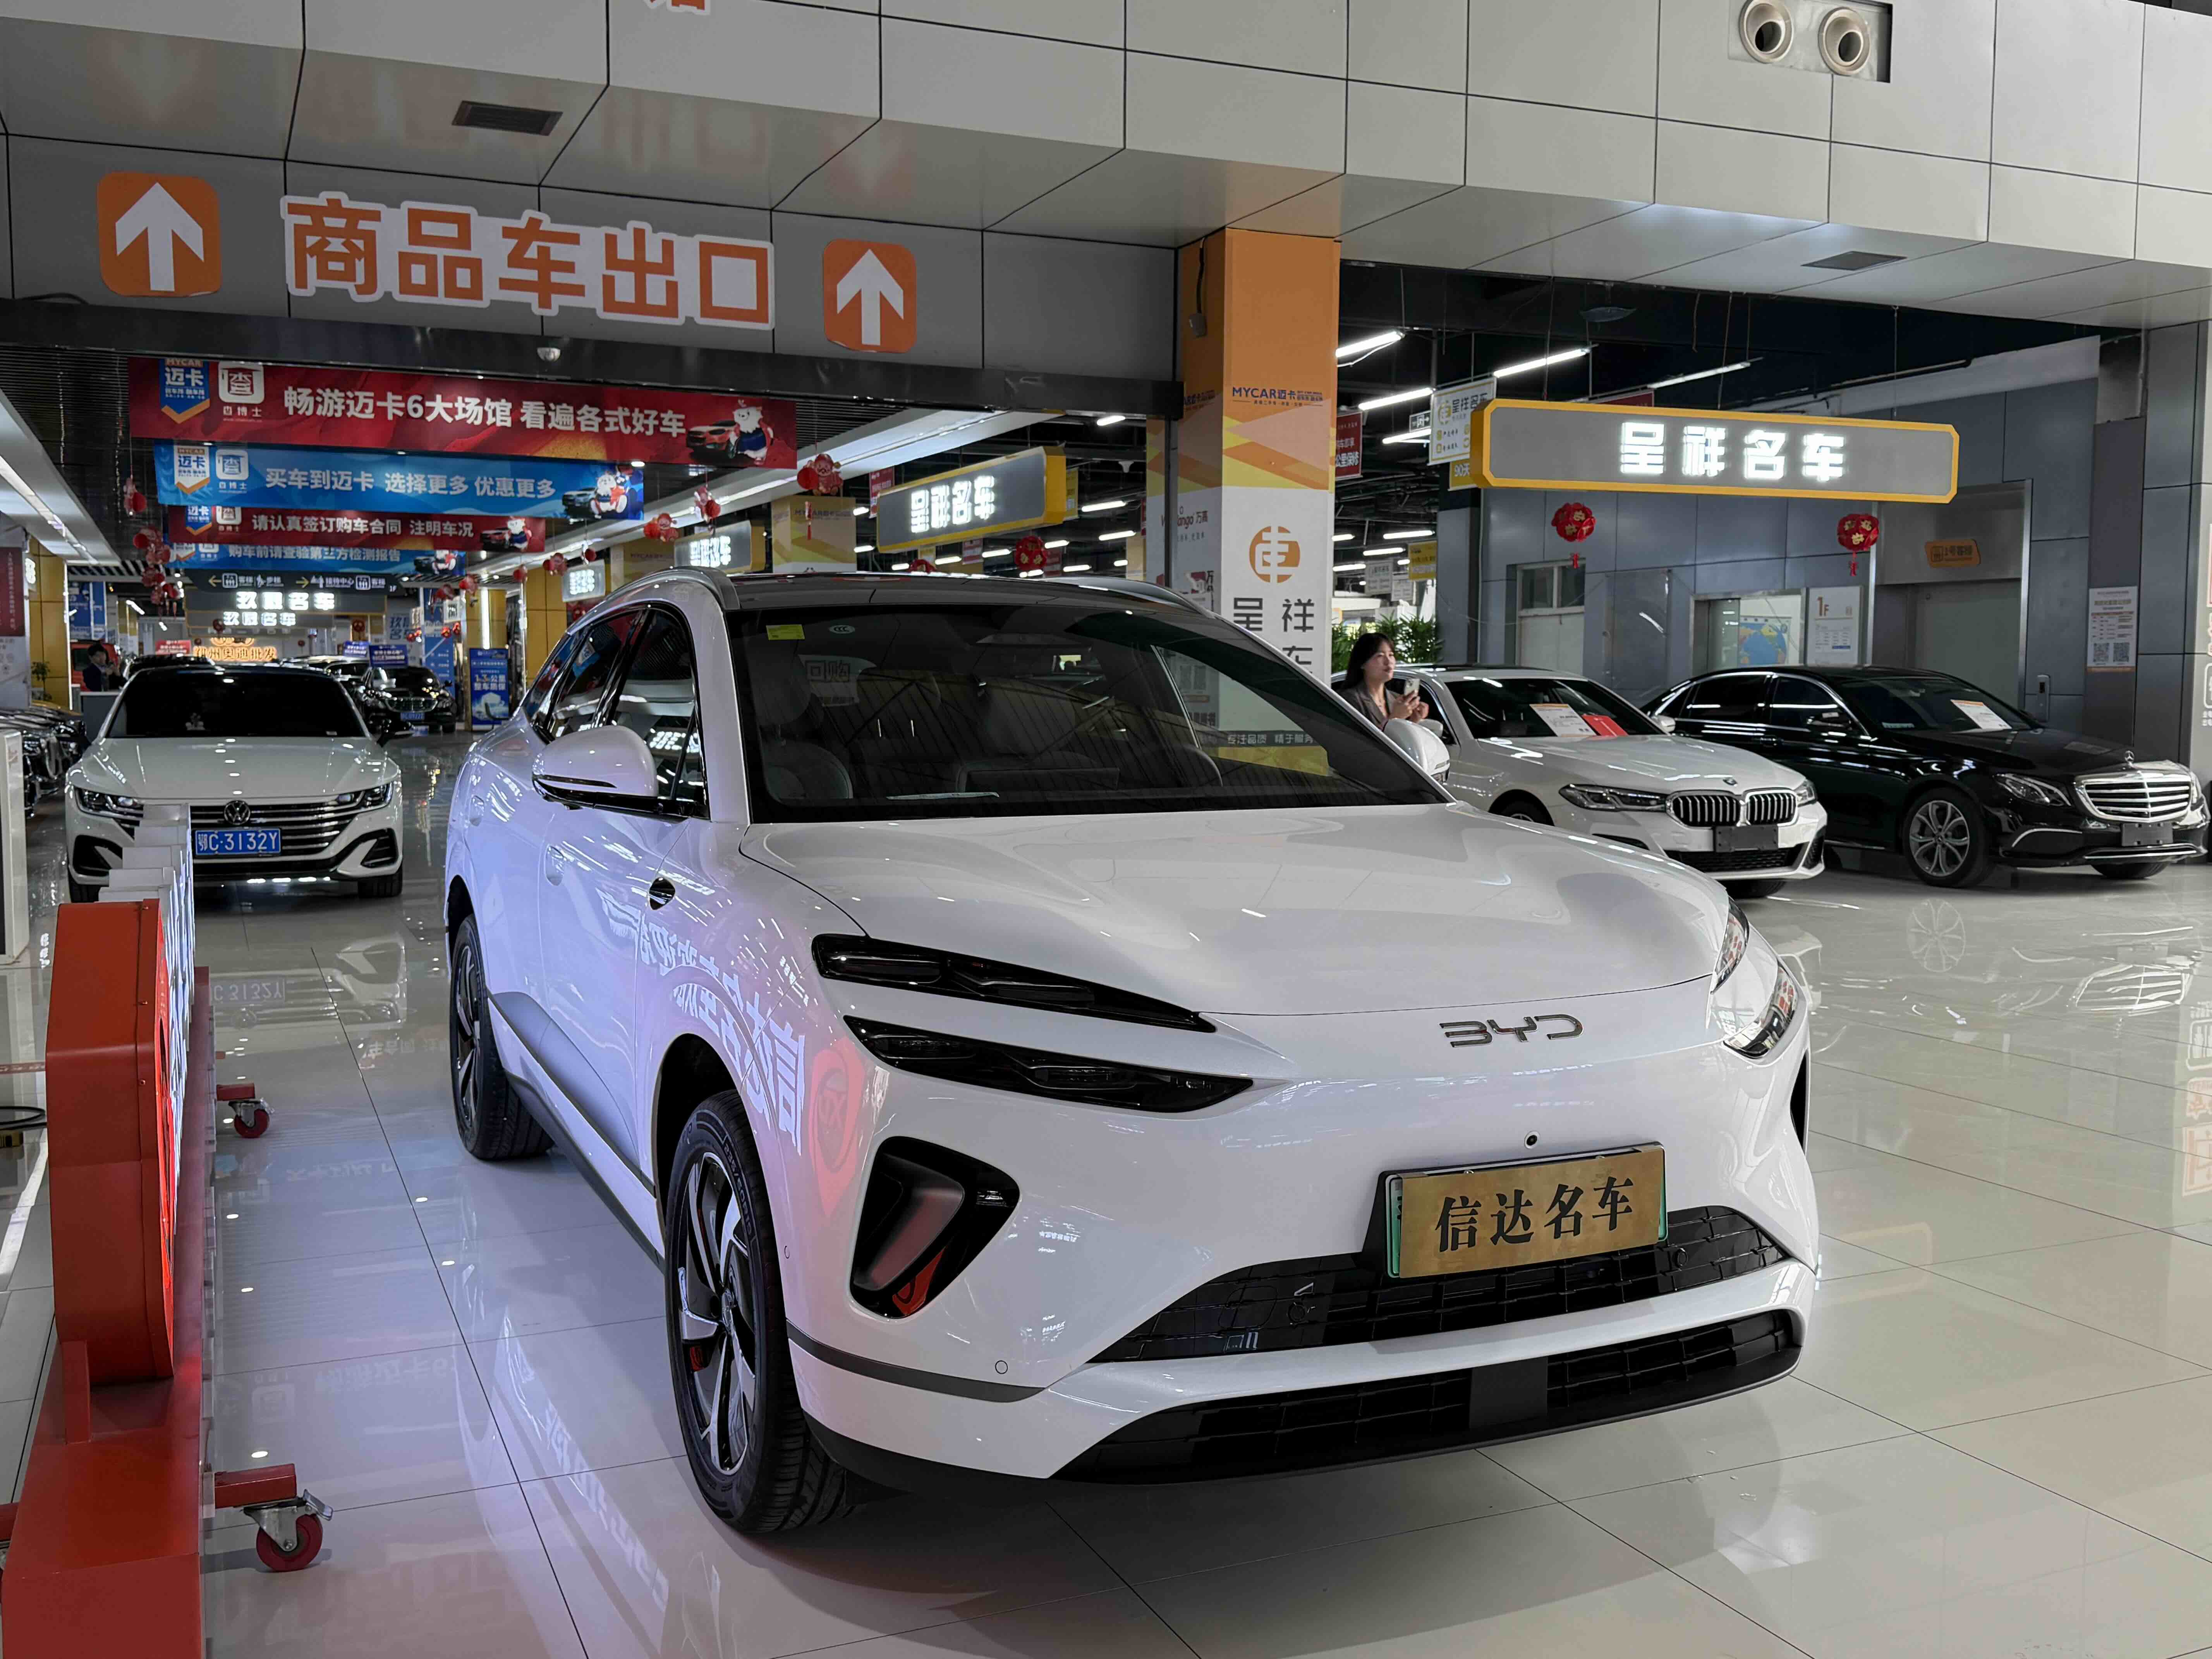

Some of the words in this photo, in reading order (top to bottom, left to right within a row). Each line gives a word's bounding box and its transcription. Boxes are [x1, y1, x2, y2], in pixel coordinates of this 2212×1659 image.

[286, 197, 770, 325] 商品车出口
[165, 367, 204, 386] 迈卡
[284, 386, 513, 428] 畅游迈卡6大场馆
[520, 400, 686, 437] 看遍各式好车
[179, 455, 205, 468] 迈卡
[1620, 421, 1847, 482] 呈祥名车
[266, 468, 374, 492] 买车到迈卡
[385, 472, 469, 496] 选择更多
[474, 476, 556, 499] 优惠更多
[251, 514, 402, 535] 请认真签订购车合同
[410, 519, 474, 538] 注明车况
[228, 544, 401, 562] 购车前请查验第三方检测报告
[1233, 597, 1315, 632] 呈祥
[1817, 596, 1830, 617] 1F
[1227, 734, 1267, 744] 专注品质
[198, 832, 278, 852] 鄂C·3132Y
[1439, 1013, 1585, 1048] BYD
[1435, 1176, 1634, 1253] 信达名车
